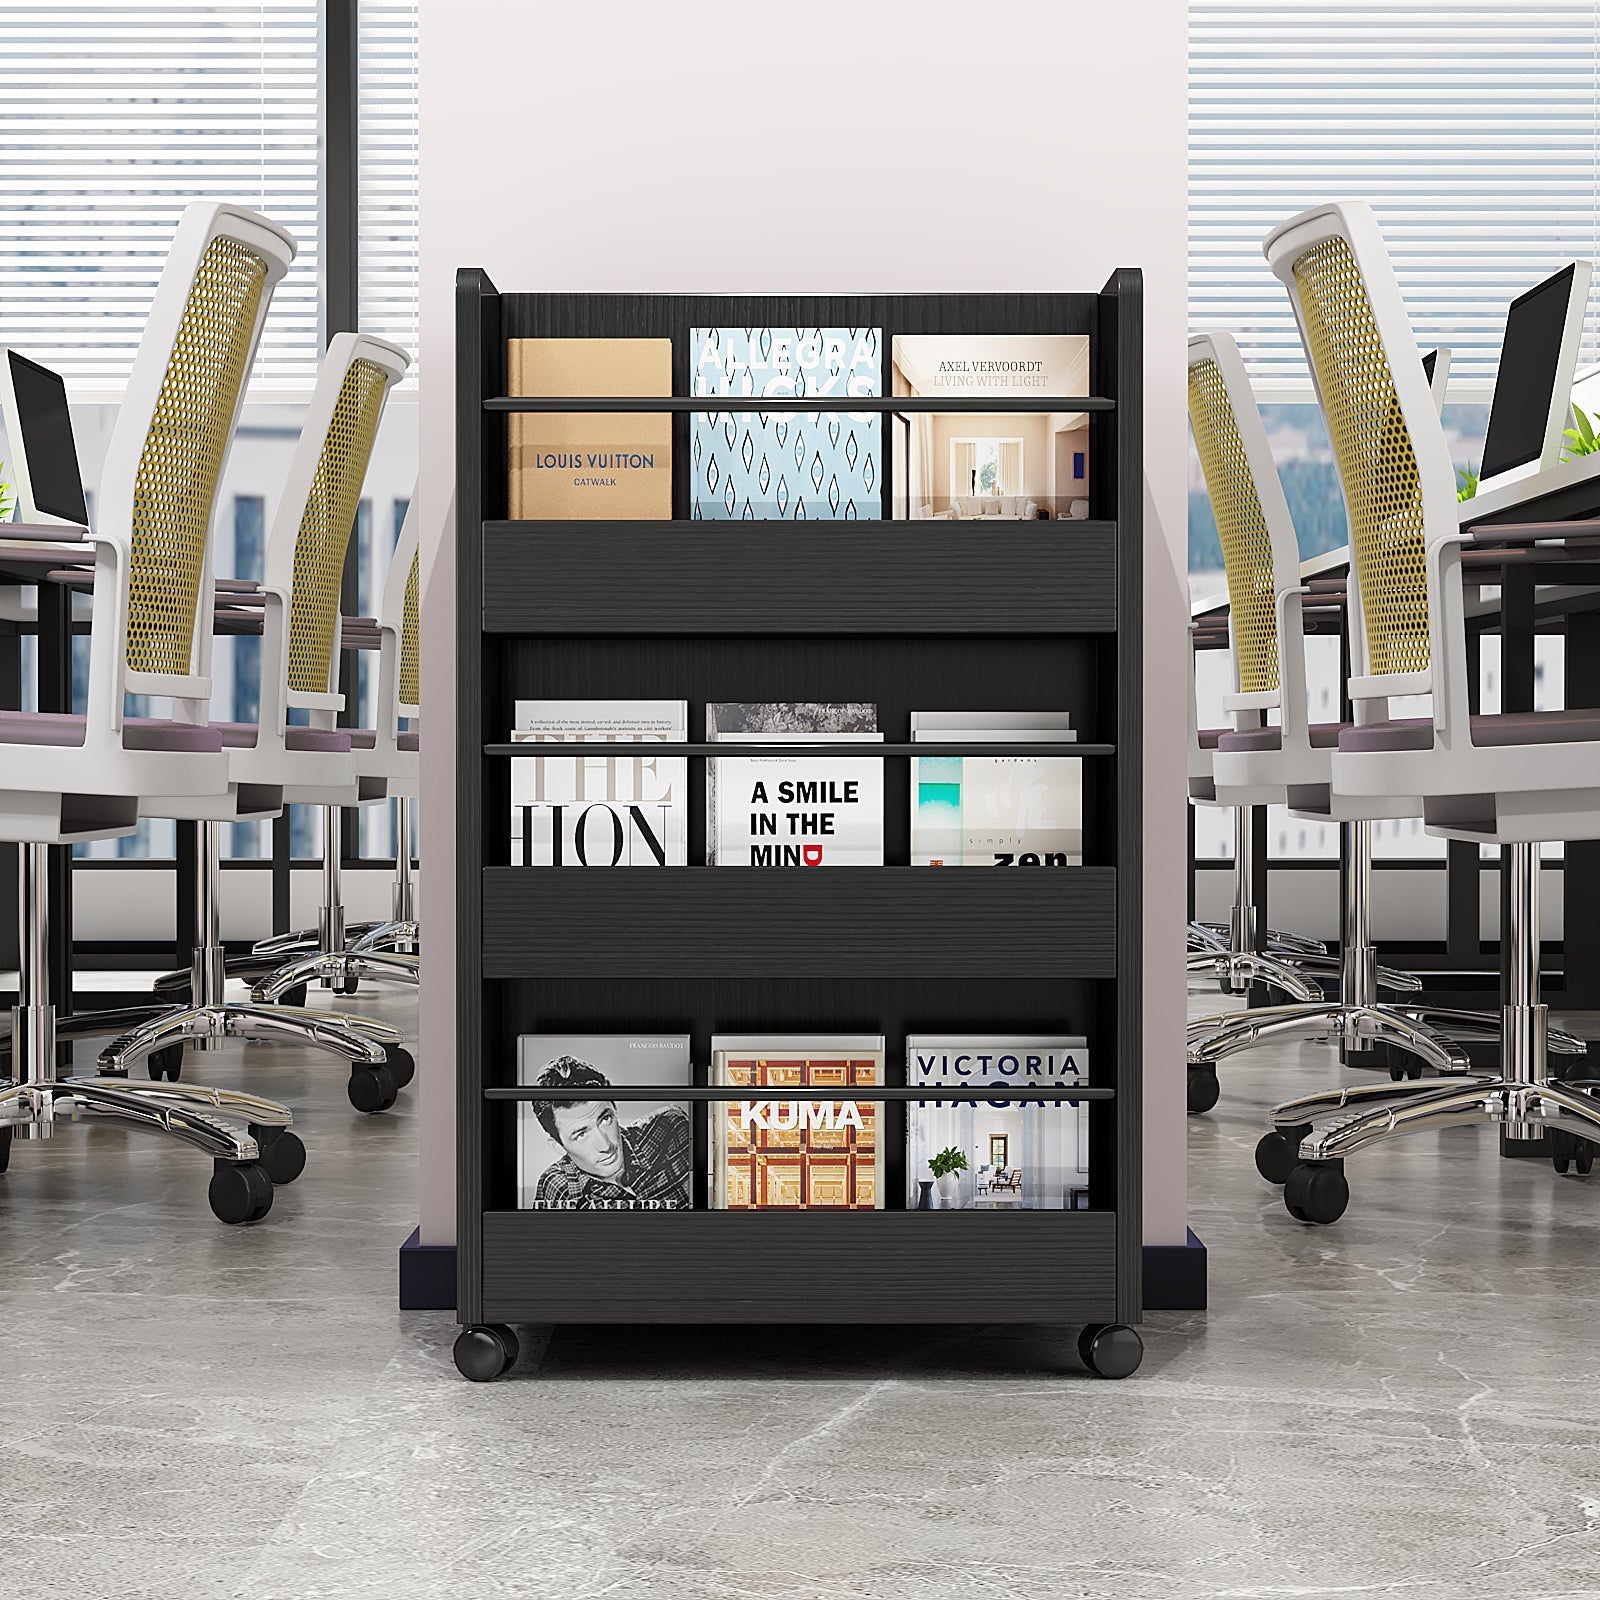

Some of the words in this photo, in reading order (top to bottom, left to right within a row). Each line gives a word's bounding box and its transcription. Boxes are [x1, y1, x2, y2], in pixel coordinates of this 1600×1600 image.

[699, 337, 876, 369] ALLEGRA
[939, 361, 970, 372] AXEL
[972, 361, 1043, 372] VERVOORDT
[934, 375, 973, 387] LIVING
[977, 375, 1008, 387] WITH
[1012, 375, 1049, 387] LIGHT
[536, 454, 582, 469] LOUIS
[587, 454, 655, 469] VUITTON
[574, 478, 617, 486] CATWALK
[515, 733, 672, 802] THE
[751, 781, 768, 803] A
[778, 781, 859, 803] SMILE
[751, 813, 776, 835] IN
[786, 813, 835, 835] THE
[969, 837, 1022, 845] simply
[751, 844, 823, 867] MIND
[917, 1055, 1080, 1076] VICTORIA
[740, 1100, 865, 1130] KUMA
